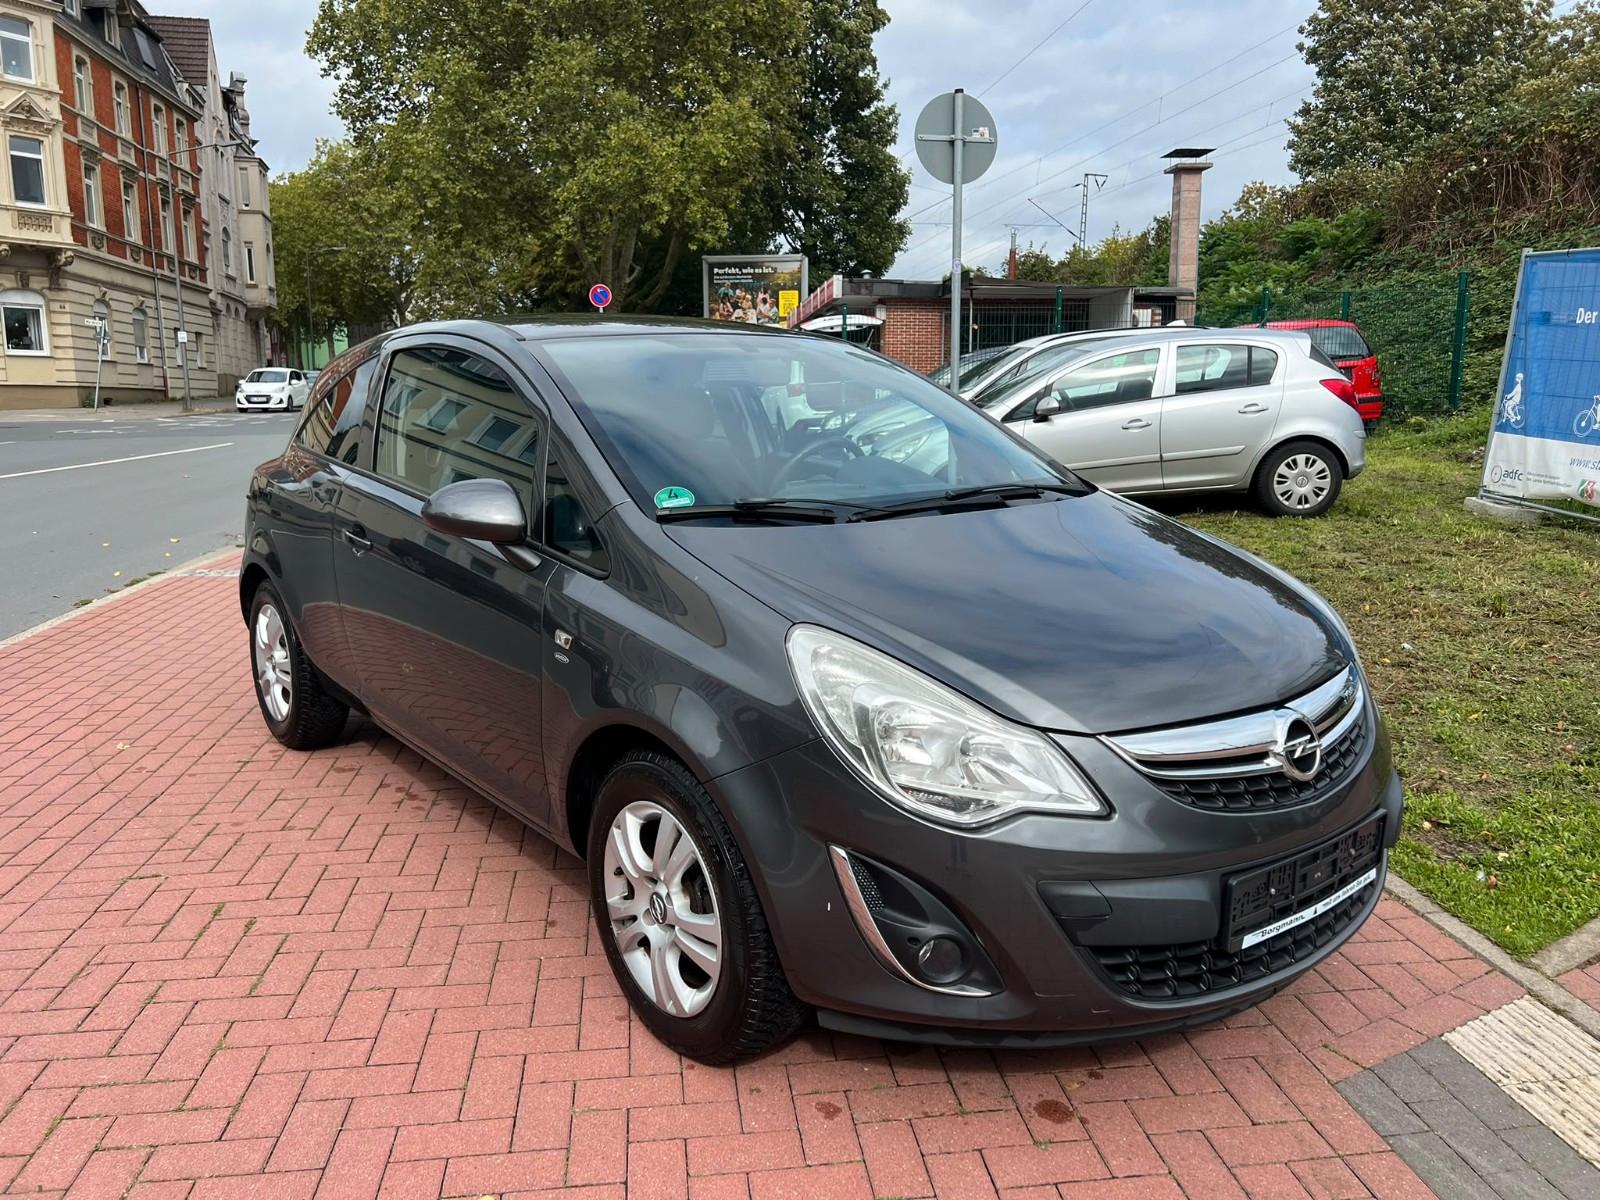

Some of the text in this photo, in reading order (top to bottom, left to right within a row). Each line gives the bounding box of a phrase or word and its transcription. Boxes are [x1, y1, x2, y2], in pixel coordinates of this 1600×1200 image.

[713, 266, 741, 275] Perfekt,
[742, 266, 754, 274] wie
[1576, 307, 1599, 324] Der
[1502, 469, 1524, 481] adfc
[667, 488, 679, 499] 4
